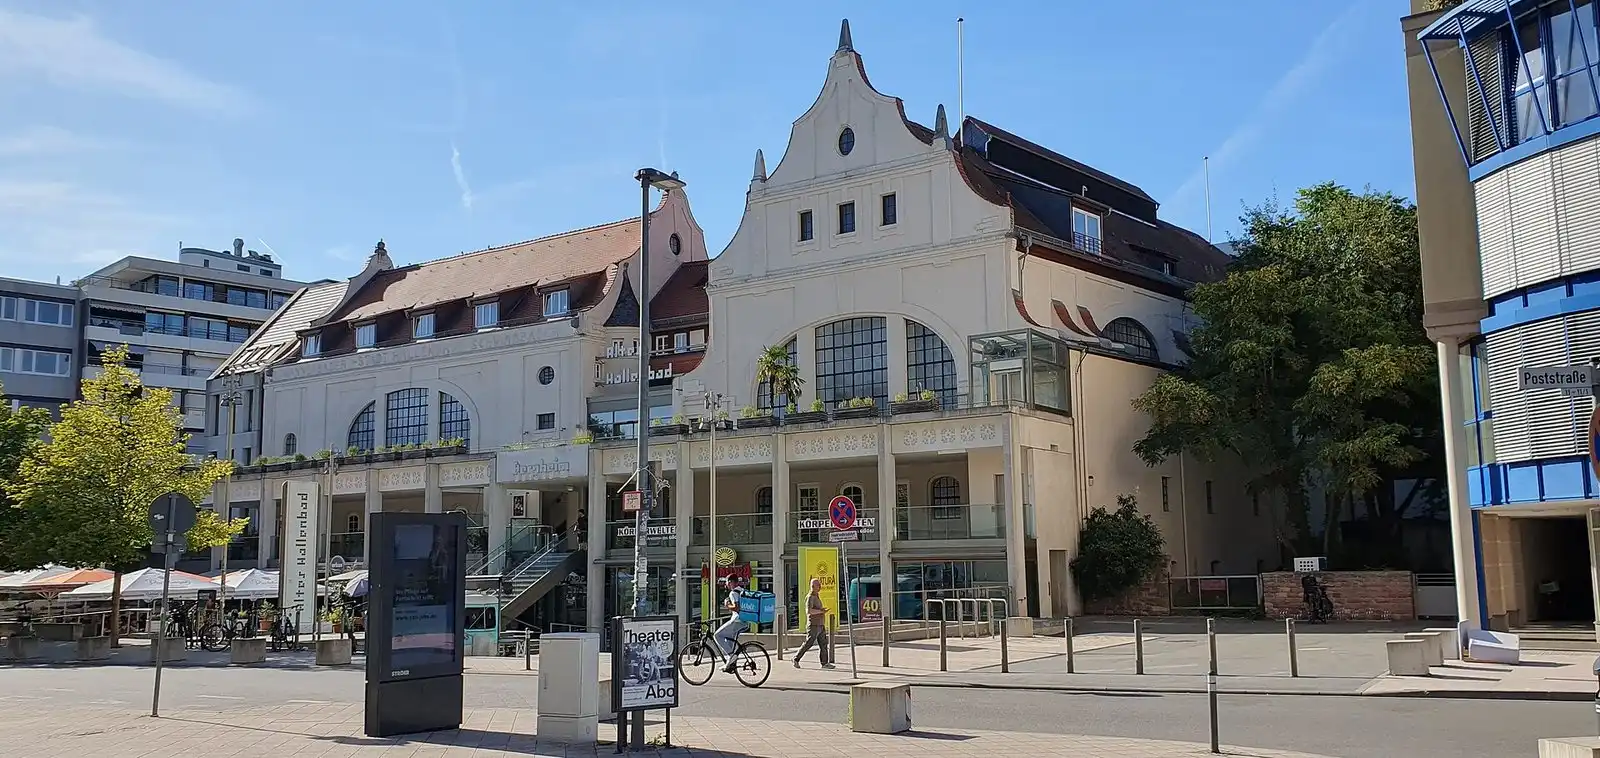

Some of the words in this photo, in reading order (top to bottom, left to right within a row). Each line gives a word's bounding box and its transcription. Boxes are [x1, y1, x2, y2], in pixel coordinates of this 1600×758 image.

[606, 344, 640, 358] Alte
[606, 362, 672, 384] Hallebad
[1524, 370, 1586, 385] Poststraße
[295, 492, 309, 566] Hallenbad
[624, 629, 675, 644] Theater
[645, 684, 675, 699] Abo
